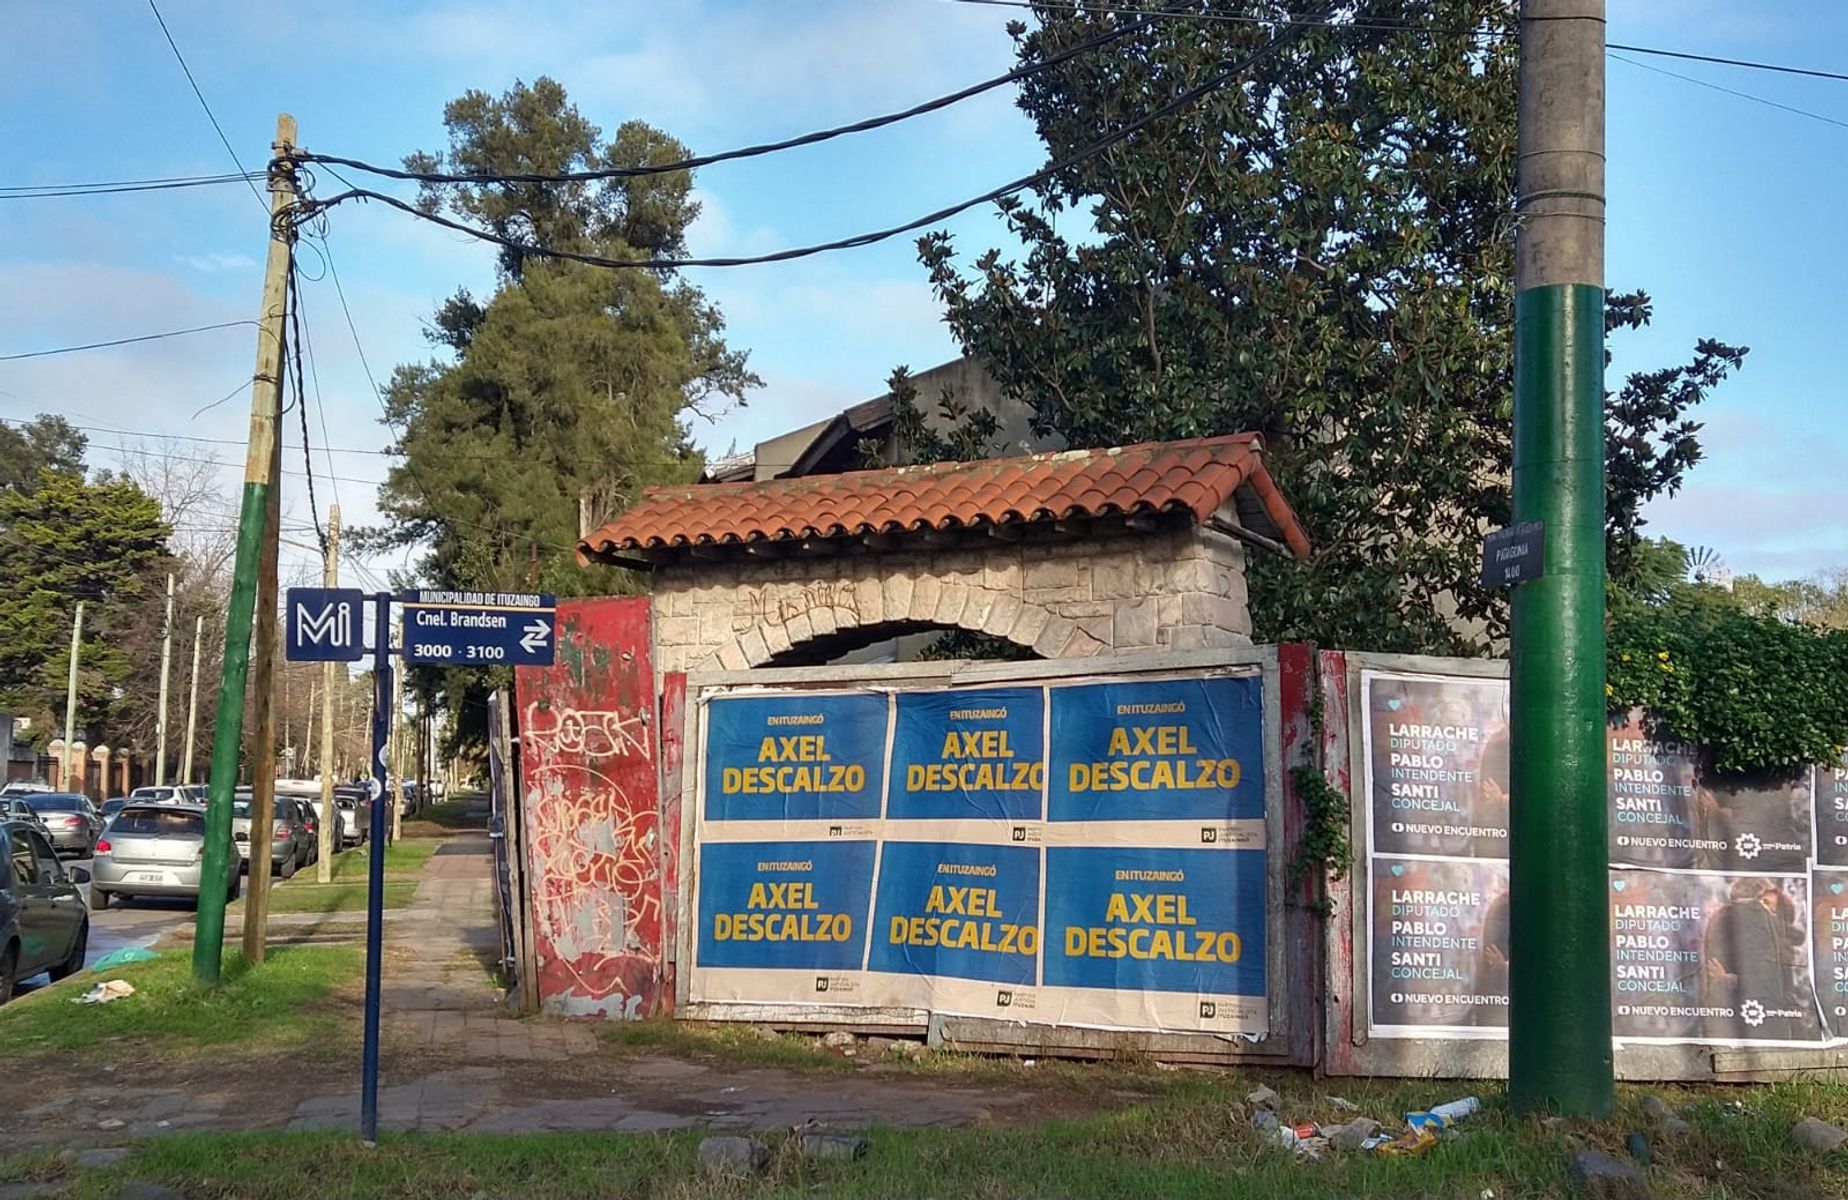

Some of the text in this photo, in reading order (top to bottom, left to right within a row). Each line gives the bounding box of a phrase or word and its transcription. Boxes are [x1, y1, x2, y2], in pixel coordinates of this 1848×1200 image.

[419, 591, 541, 607] MUNICIPALIDAD DE ITUZAINGO
[416, 610, 508, 628] Cnel. Brandsen
[414, 644, 504, 659] 3000 3100
[950, 710, 962, 720] EN
[1117, 705, 1130, 715] EN
[767, 716, 778, 726] EN
[1389, 723, 1479, 740] LARRACHE
[942, 730, 1014, 759] AXEL
[1108, 726, 1197, 756] AXEL
[1390, 738, 1456, 751] DIPUTADO
[758, 735, 831, 763] AXEL
[1391, 753, 1443, 768] PABLO
[1612, 752, 1680, 765] DIPUTADO
[722, 764, 865, 794] DESCALZO
[906, 762, 1044, 791] DESCALZO
[1068, 758, 1241, 792] DESCALZO
[1391, 768, 1473, 783] INTENDENTE
[1614, 768, 1664, 783] PABLO
[1391, 783, 1439, 798] SANTI
[1615, 783, 1691, 796] INTENDENTE
[1391, 798, 1460, 812] CONCEJAL
[1616, 797, 1662, 812] SANTI
[1617, 812, 1684, 825] CONCEJAL
[1406, 823, 1508, 838] NUEVO ENCUENTRO
[1630, 837, 1728, 850] NUEVO ENCUENTRO
[757, 861, 768, 871] EN
[938, 864, 949, 874] EN
[1115, 869, 1129, 881] EN
[747, 882, 819, 909] AXEL
[925, 885, 1002, 918] AXEL
[1392, 890, 1480, 906] LARRACHE
[1106, 893, 1196, 925] AXEL
[1392, 904, 1460, 918] DIPUTADO
[1615, 905, 1700, 920] LARRACHE
[714, 913, 852, 942] DESCALZO
[1392, 920, 1446, 935] PABLO
[1616, 919, 1681, 932] DIPUTADO
[889, 916, 1038, 956] DESCALZO
[1391, 936, 1477, 949] INTENDENTE
[1616, 935, 1669, 949] PABLO
[1065, 926, 1242, 963] DESCALZO
[1391, 952, 1441, 966] SANTI
[1616, 950, 1698, 962] INTENDENTE
[1391, 967, 1463, 980] CONCEJAL
[1617, 965, 1664, 979] SANTI
[1617, 980, 1687, 993] CONCEJAL
[1405, 993, 1509, 1005] NUEVO ENCUENTRO
[1632, 1006, 1669, 1016] NUEVO
[1670, 1006, 1734, 1018] ENCUENTRO
